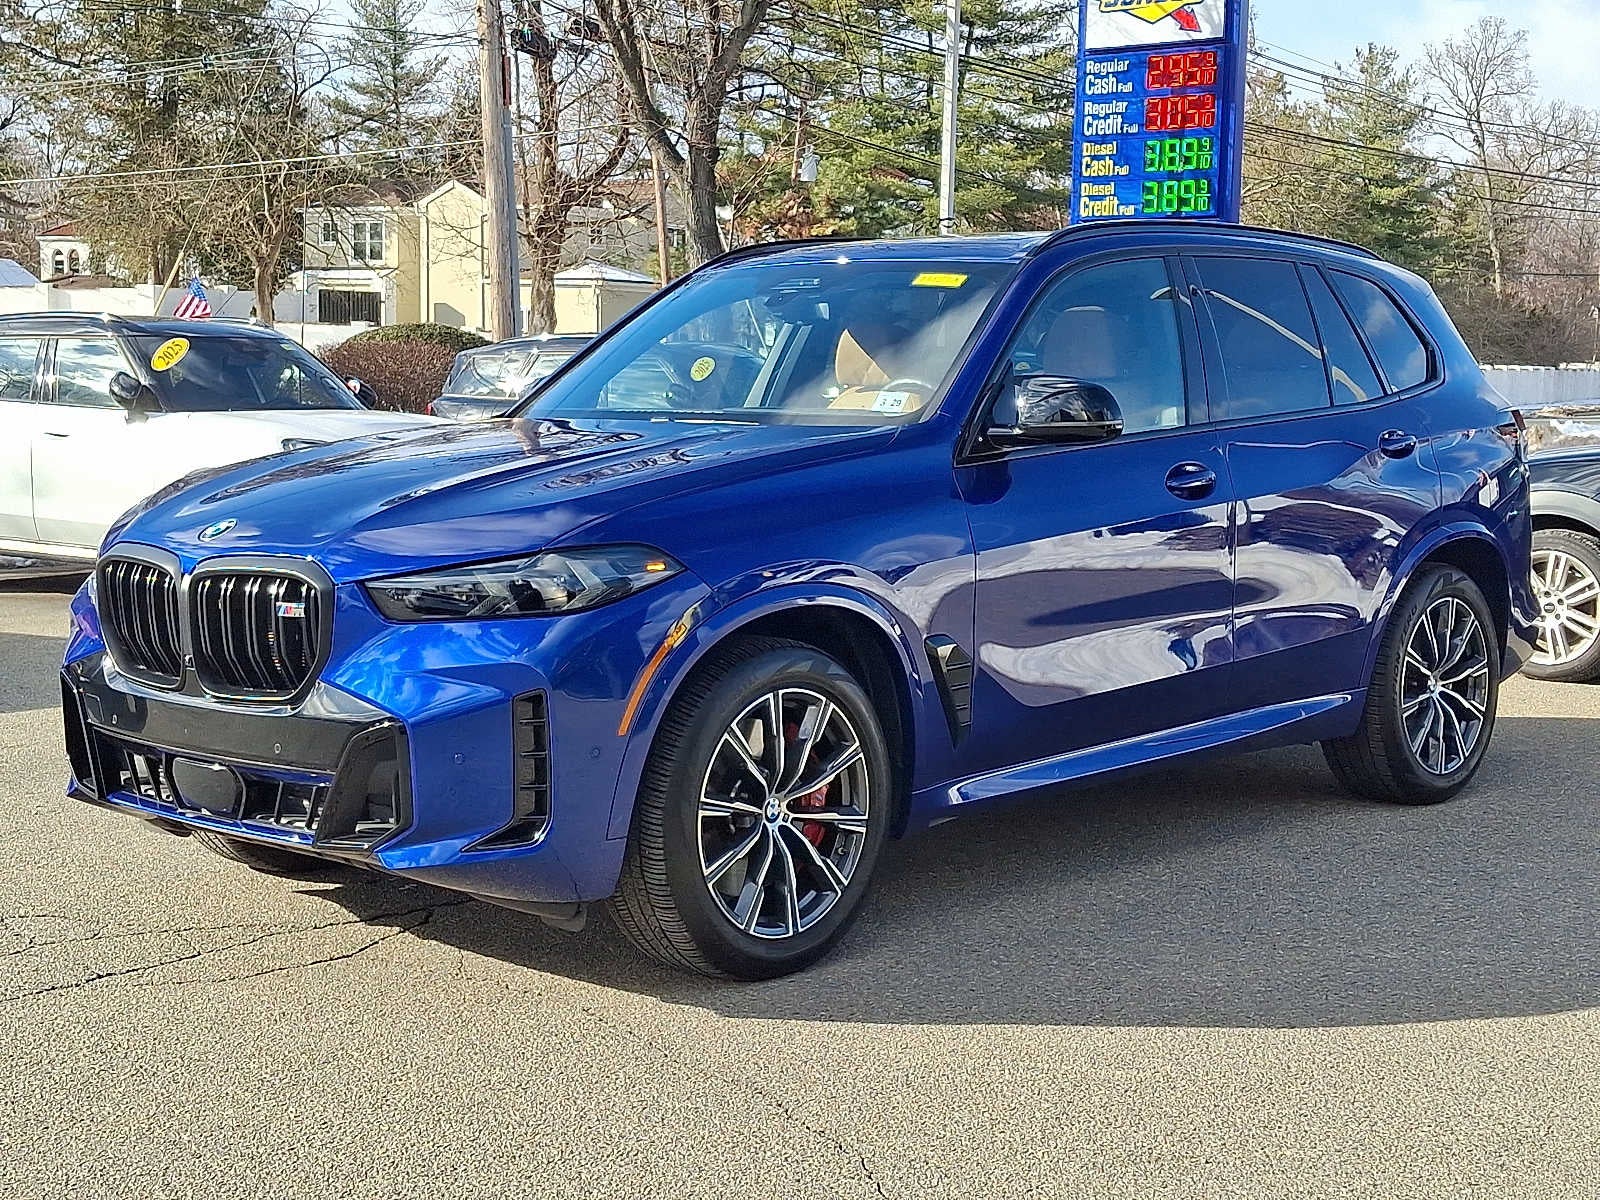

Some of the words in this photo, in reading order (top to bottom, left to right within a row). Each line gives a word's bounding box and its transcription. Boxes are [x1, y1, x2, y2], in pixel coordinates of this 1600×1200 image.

[1086, 58, 1130, 75] Regular
[1085, 72, 1117, 95] Cash
[1117, 82, 1133, 93] Full
[1083, 100, 1129, 117] Regular
[1083, 114, 1123, 136] Credit
[1123, 123, 1139, 134] Full
[1082, 141, 1117, 156] Diesel
[1081, 156, 1114, 177] Cash
[1114, 165, 1129, 176] Full
[1080, 181, 1115, 197] Diesel
[1079, 196, 1119, 217] Credit
[1119, 205, 1135, 216] Full
[157, 340, 183, 366] 2025
